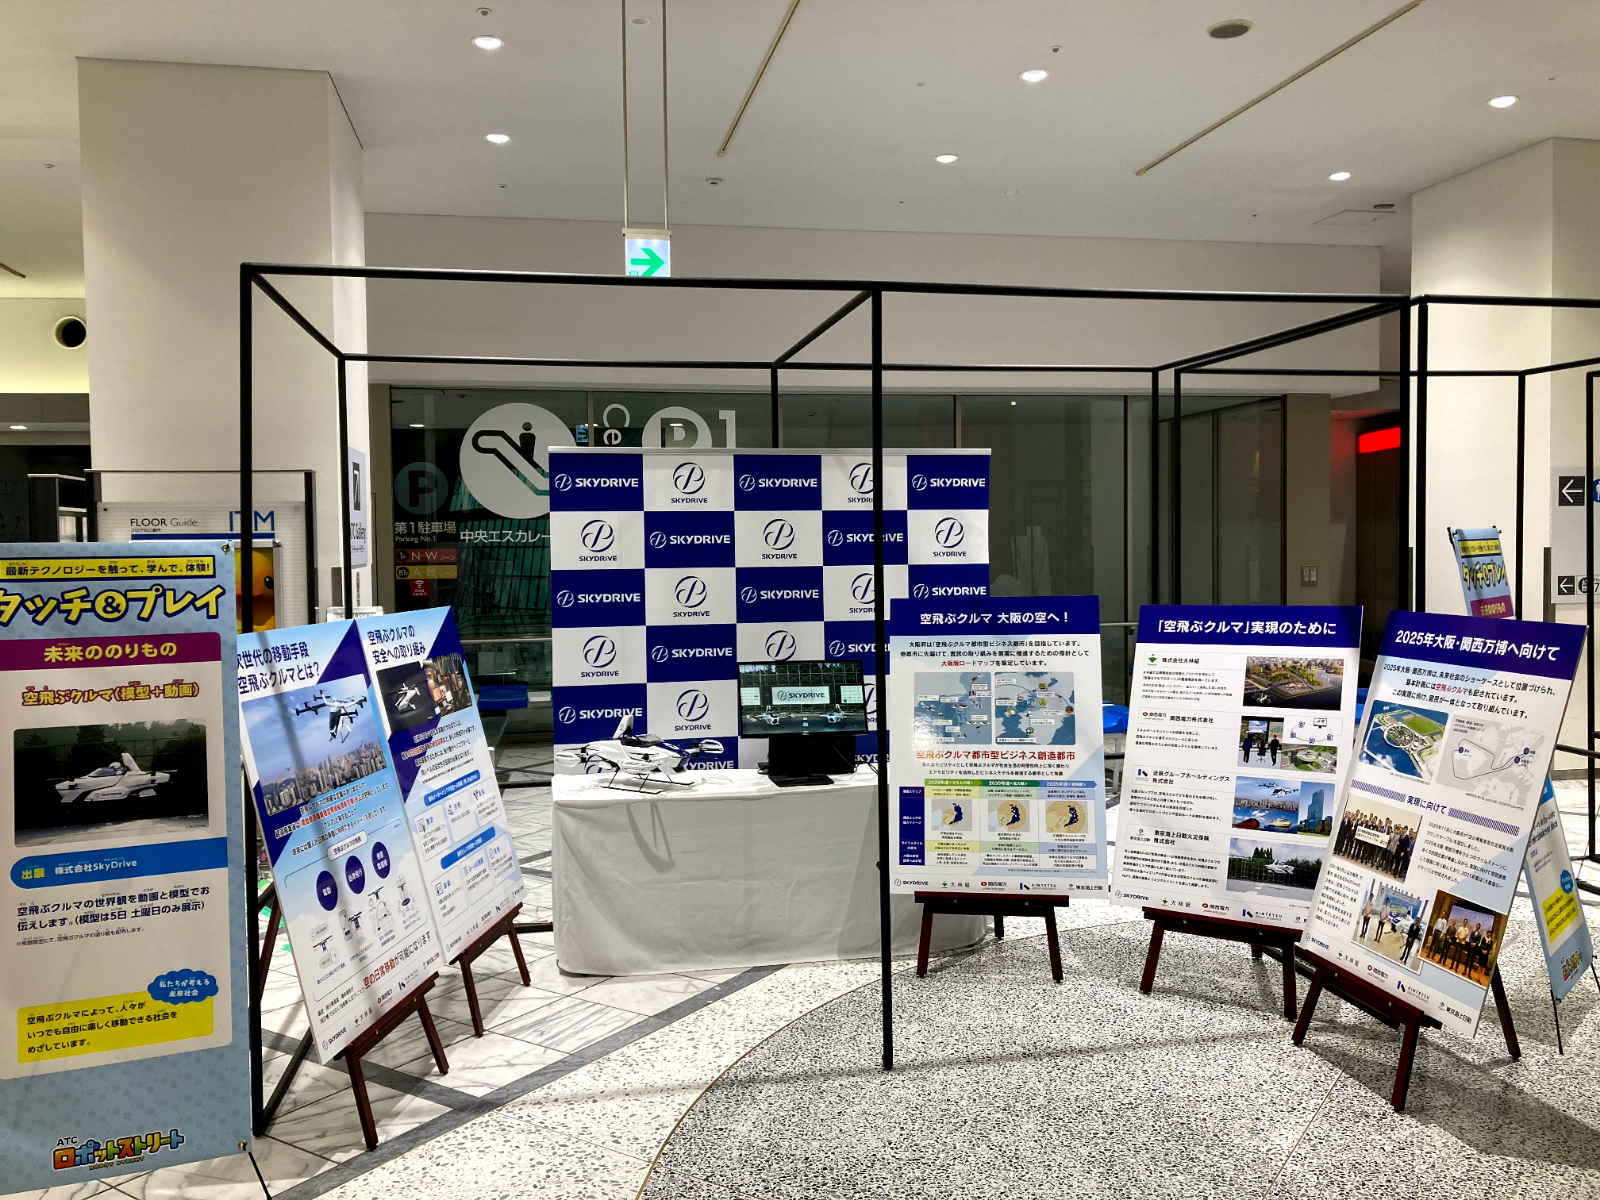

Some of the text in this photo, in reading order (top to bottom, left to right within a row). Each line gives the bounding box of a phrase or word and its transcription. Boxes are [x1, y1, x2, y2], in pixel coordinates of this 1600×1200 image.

[575, 478, 638, 487] SKYDRIVE
[758, 478, 818, 487] SKYDRIVE
[929, 478, 985, 487] SKYDRIVE
[130, 517, 198, 527] FLOOR Guide
[394, 521, 456, 534] 第1駐車場
[669, 535, 730, 544] SKYDRIVE
[6, 562, 210, 577] 最新テクノロジーを触って、学んで、体験!
[760, 589, 819, 599] SKYDRIVE
[931, 586, 987, 596] SKYDRIVE
[577, 593, 641, 603] SKYDRIVE
[0, 583, 225, 627] タッチ&プレイ
[920, 612, 1068, 625] 空飛ぶクルマ 大阪の空へ!
[1157, 619, 1337, 635] 「空飛ぶクルマ」実現のために
[367, 625, 415, 646] 空飛ぶクルマの
[44, 641, 177, 663] 未来ののりもの
[1395, 630, 1560, 661] 2025年大阪・関西万博へ向けて
[372, 642, 426, 665] 安全への取り組み
[672, 647, 733, 658] SKYDRIVE
[238, 662, 320, 695] 空飛ぶクルマとは?
[579, 707, 643, 719] SKYDRIVE
[916, 750, 1075, 760] 空飛ぶクルマ都市型ビジネス創造都市
[1406, 795, 1448, 814] 実現に向けて
[21, 858, 137, 880] 出展 株式会社SkyDrive
[17, 886, 210, 917] 空飛ぶクルマの世界観を動画と模型でお
[159, 977, 210, 989] 私たちが考える
[168, 989, 199, 998] 未来社会
[27, 1001, 146, 1026] 空飛ぶクルマによって、人々が
[27, 1010, 178, 1039] いつでも自由に楽しく移動できる社会を
[27, 1038, 91, 1054] めざしています。
[56, 1136, 78, 1146] ATC
[53, 1129, 185, 1170] ロボットストリート
